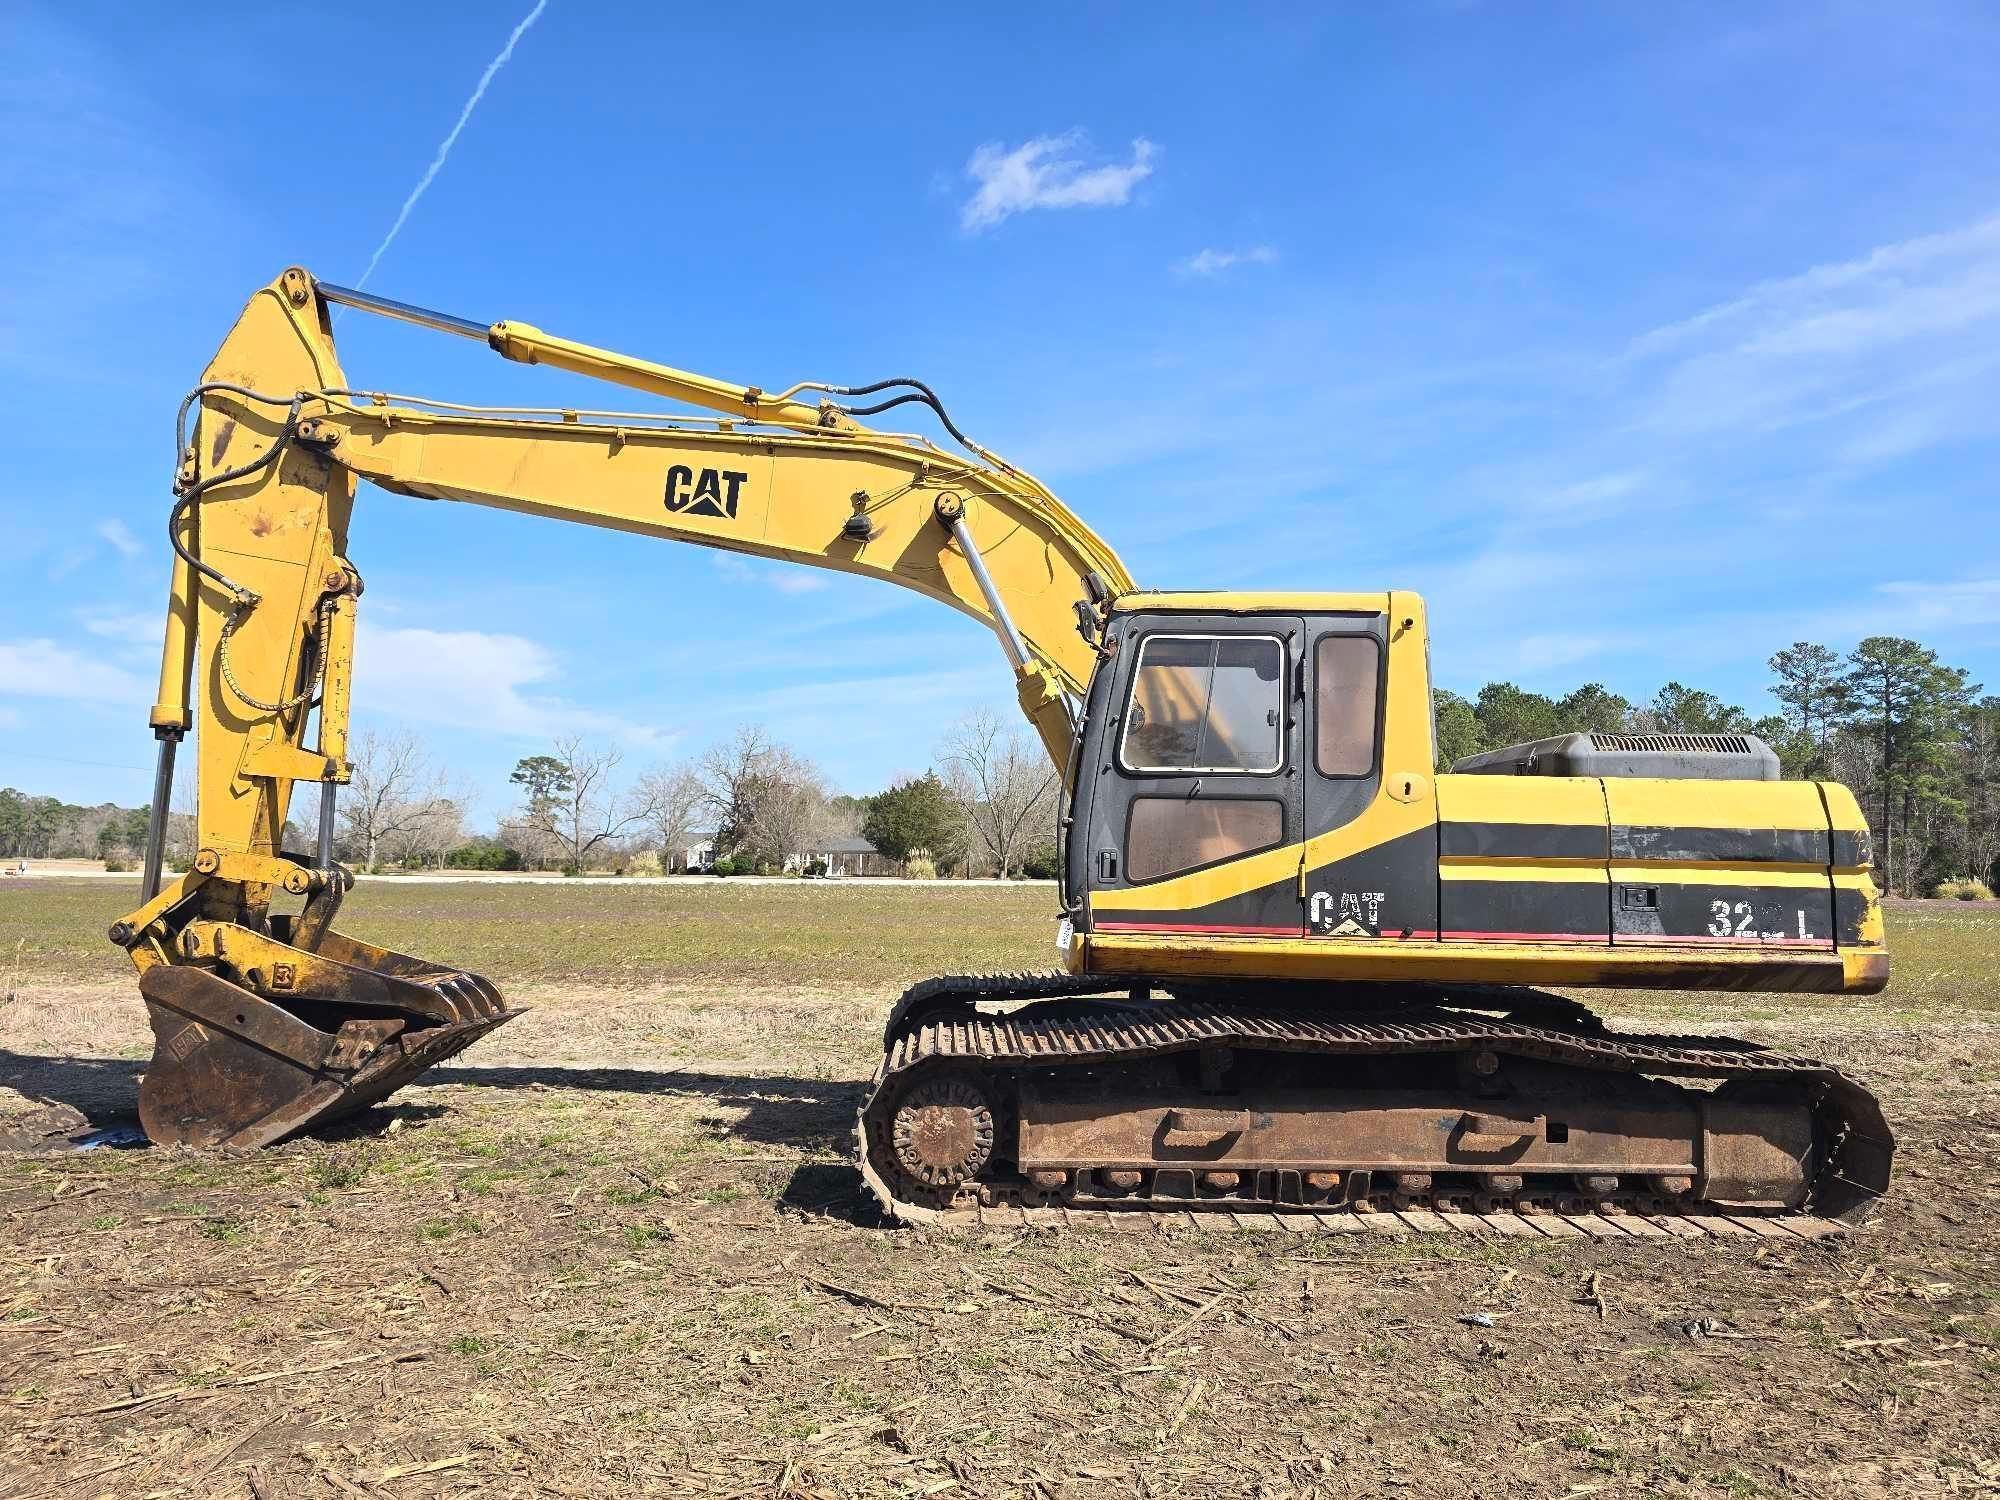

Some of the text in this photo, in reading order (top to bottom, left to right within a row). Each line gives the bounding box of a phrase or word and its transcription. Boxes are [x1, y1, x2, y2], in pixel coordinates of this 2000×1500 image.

[664, 464, 748, 520] CAT
[1310, 891, 1385, 936] CAT
[1797, 909, 1814, 939] L
